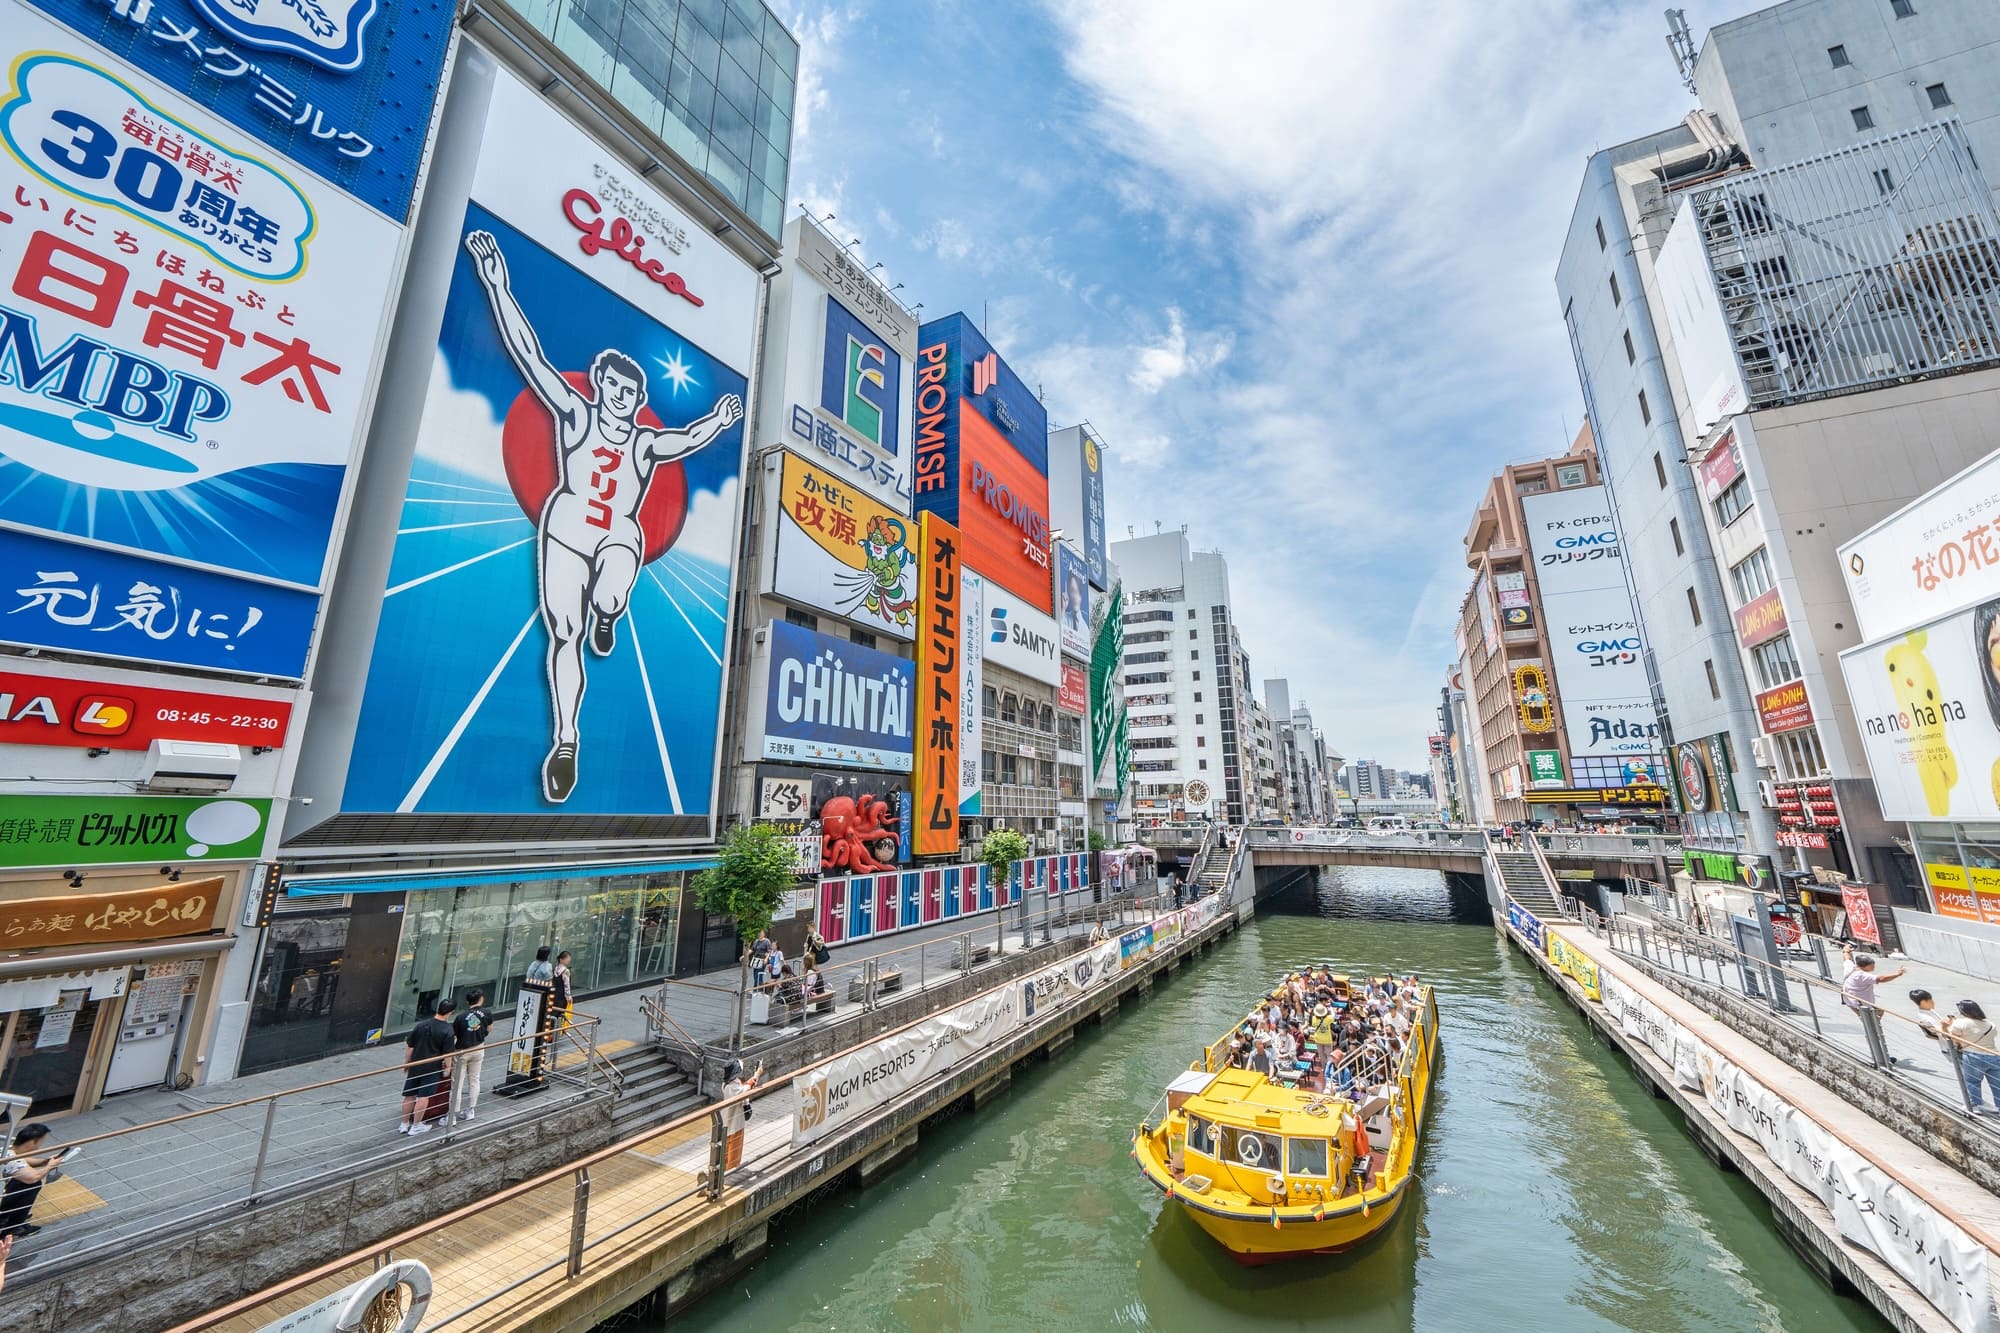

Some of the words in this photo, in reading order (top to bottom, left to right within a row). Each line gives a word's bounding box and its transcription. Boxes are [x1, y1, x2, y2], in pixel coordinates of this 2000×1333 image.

[122, 115, 243, 195] 毎日骨太
[178, 209, 272, 264] ありがとう
[0, 210, 341, 414] 日骨太
[916, 342, 948, 494] PROMISE
[585, 446, 624, 531] グリコ
[803, 472, 854, 513] かぜに
[972, 460, 1048, 548] PROMISE
[795, 491, 857, 546] 改源
[1023, 537, 1048, 570] プロミス
[1013, 622, 1055, 661] SAMTY
[1589, 652, 1636, 667] コイン
[930, 537, 956, 831] オリエントホーム
[966, 670, 974, 733] Asue
[1762, 693, 1781, 712] LONG
[1782, 686, 1803, 705] DINH
[1535, 754, 1556, 770] 薬
[77, 813, 178, 847] ピタットハウス
[828, 1075, 860, 1104] MGM
[862, 1049, 915, 1088] RESORTS
[827, 1100, 849, 1118] JAPAN
